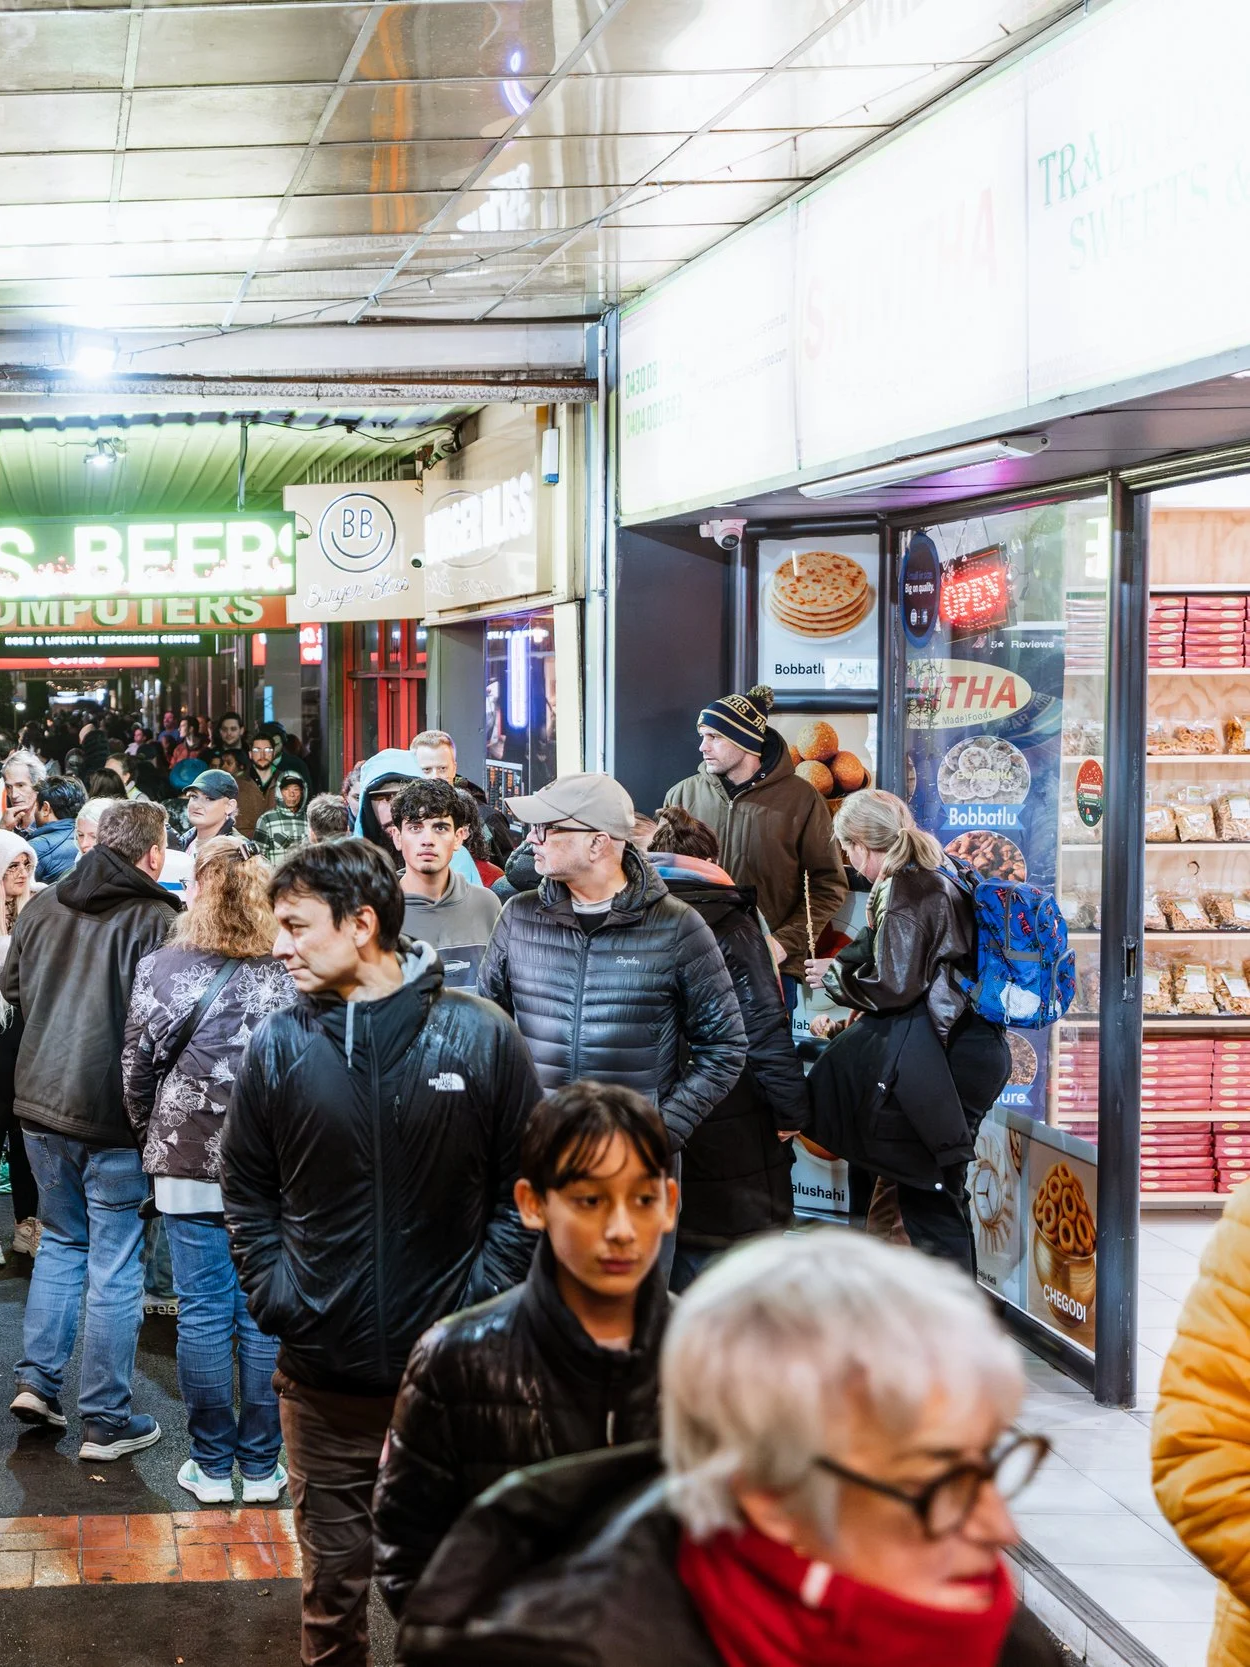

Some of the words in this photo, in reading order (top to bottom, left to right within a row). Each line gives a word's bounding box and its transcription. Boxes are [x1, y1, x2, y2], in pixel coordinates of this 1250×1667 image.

[343, 508, 373, 539] BB
[904, 583, 913, 595] Big
[942, 570, 1000, 621] OPEN
[5, 635, 34, 646] HOME
[45, 635, 96, 646] LIFESTYLE
[97, 635, 159, 645] EXPERIENCE
[161, 634, 200, 644] CENTRE
[1011, 640, 1055, 649] Reviews
[949, 806, 1018, 826] Bobbatlu
[616, 955, 640, 967] Rapha
[428, 1078, 452, 1086] NORTH
[792, 1182, 845, 1203] alushahi
[1043, 1283, 1087, 1323] CHEGODI
